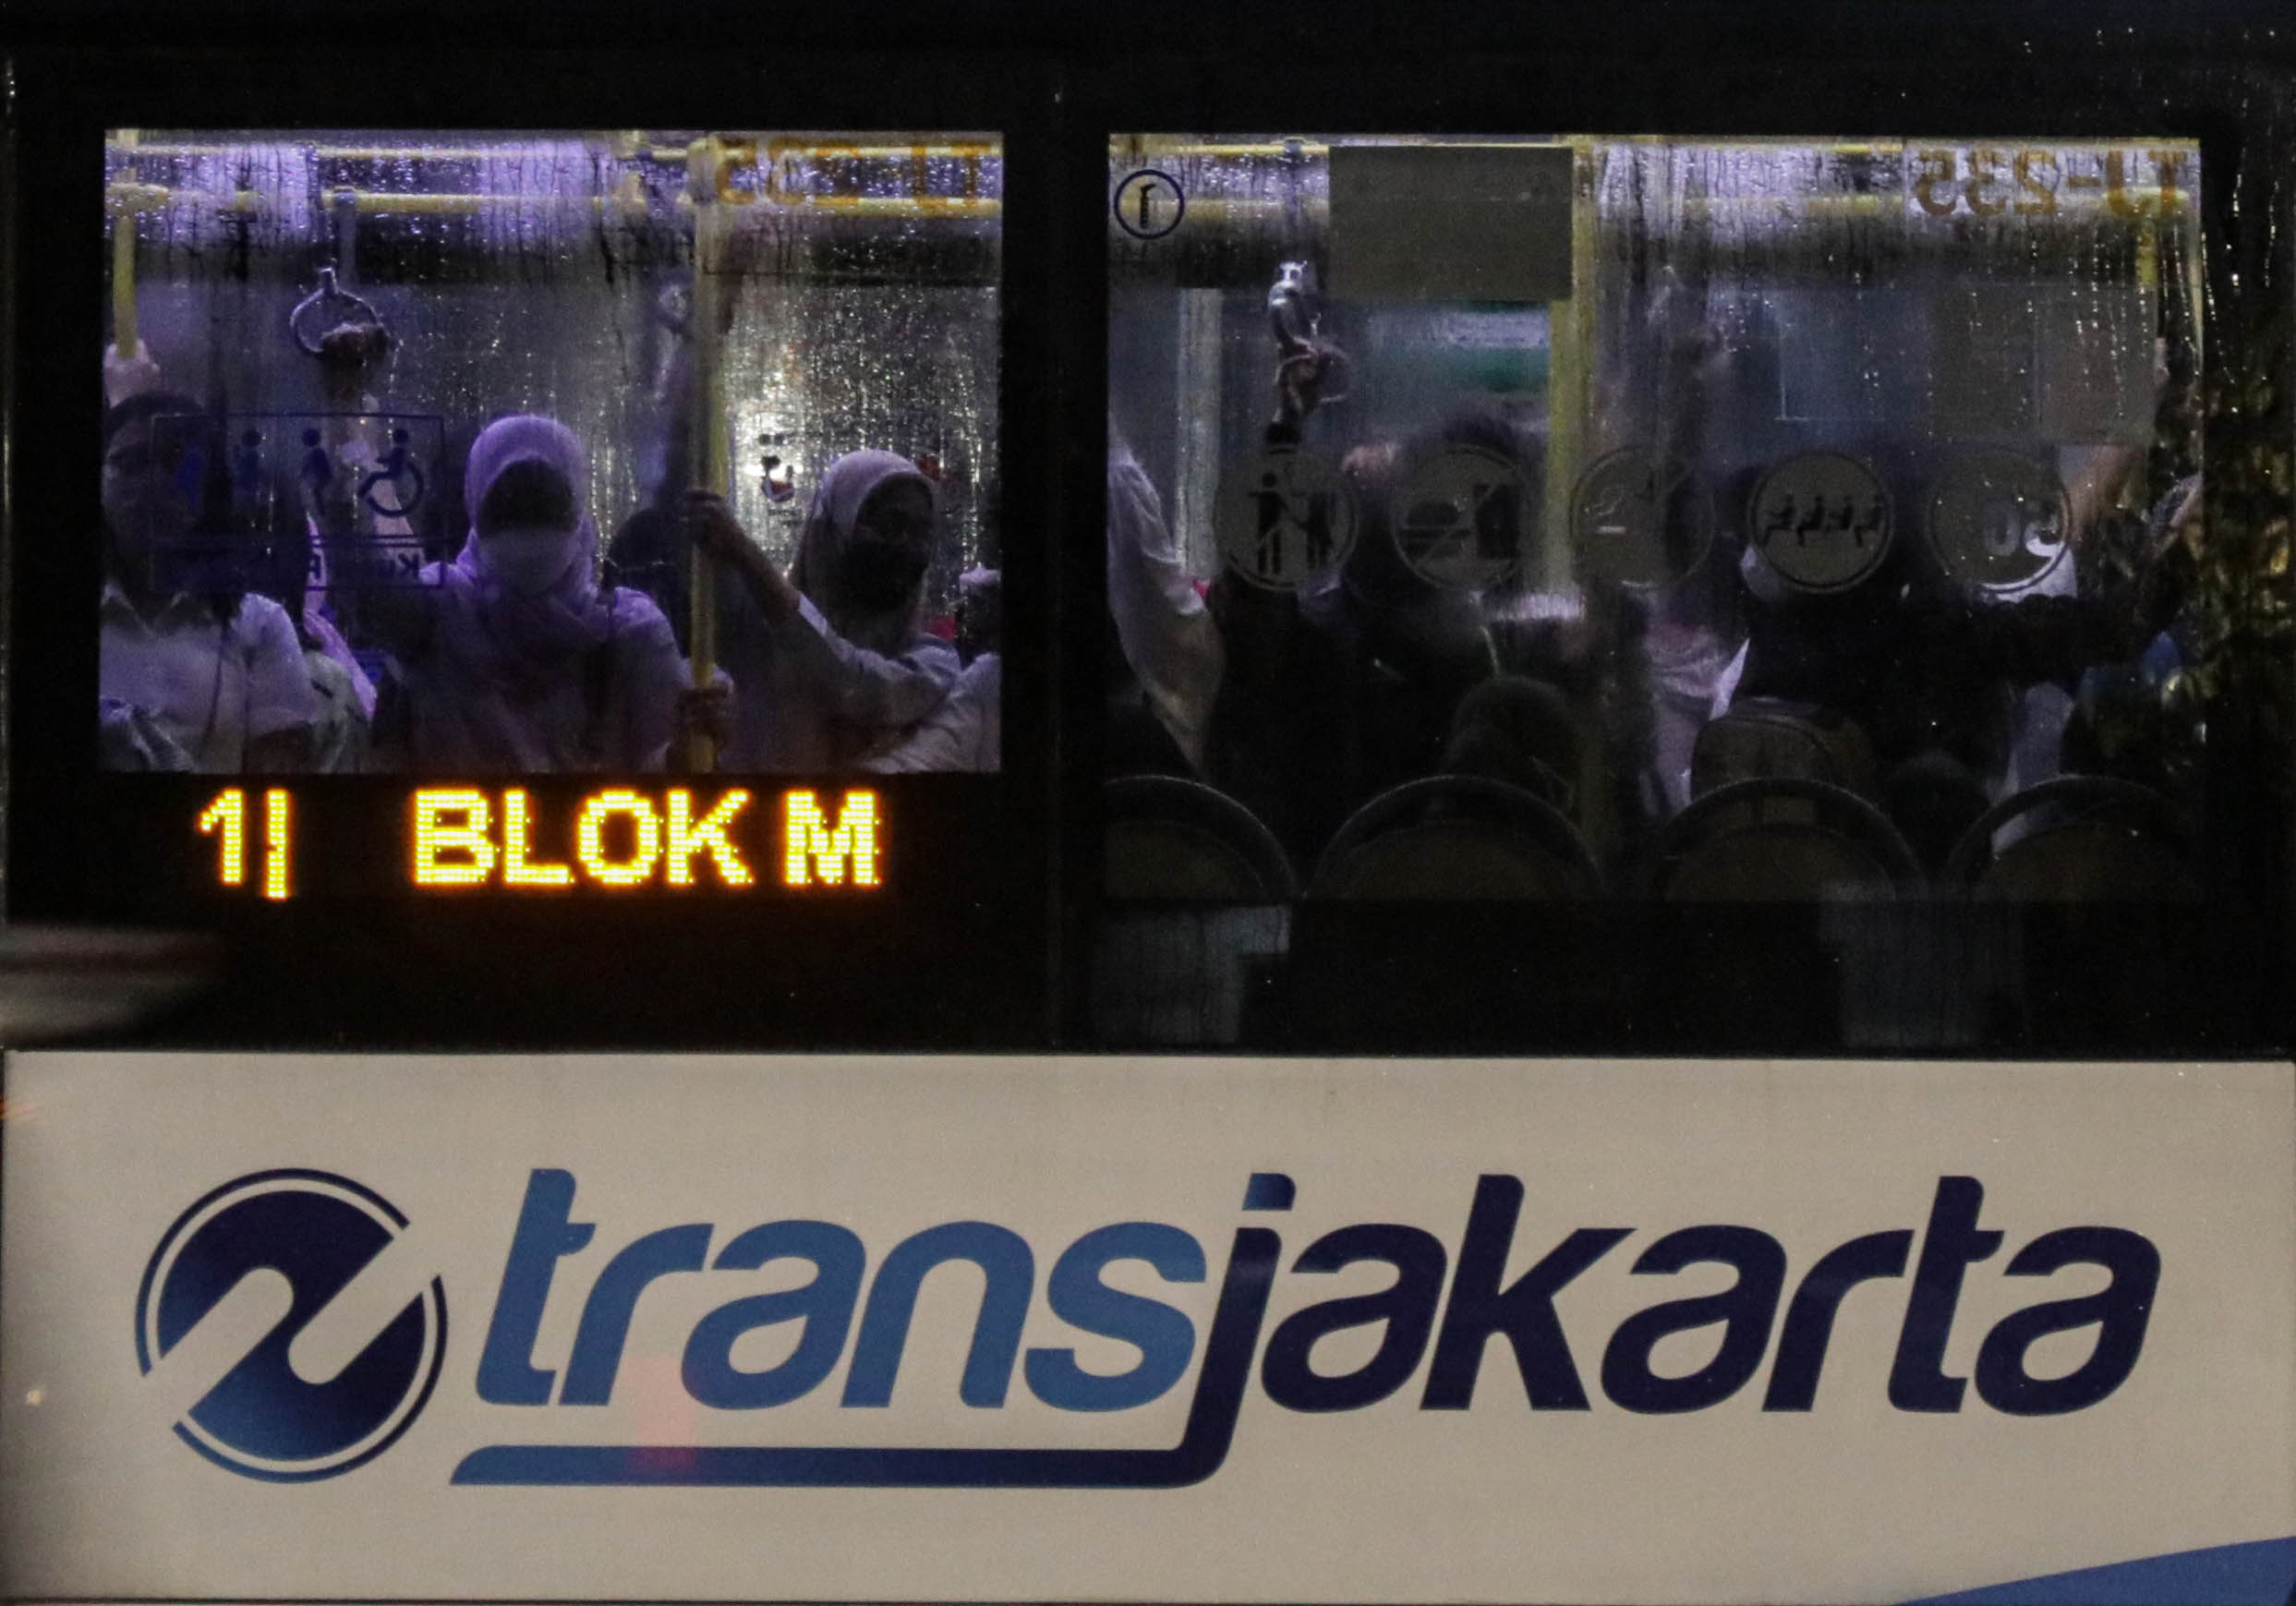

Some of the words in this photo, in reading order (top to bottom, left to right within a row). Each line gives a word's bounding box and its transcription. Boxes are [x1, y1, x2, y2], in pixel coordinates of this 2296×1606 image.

[412, 788, 754, 888] BLOK
[782, 788, 883, 888] M
[451, 1167, 2162, 1489] transjakarta
